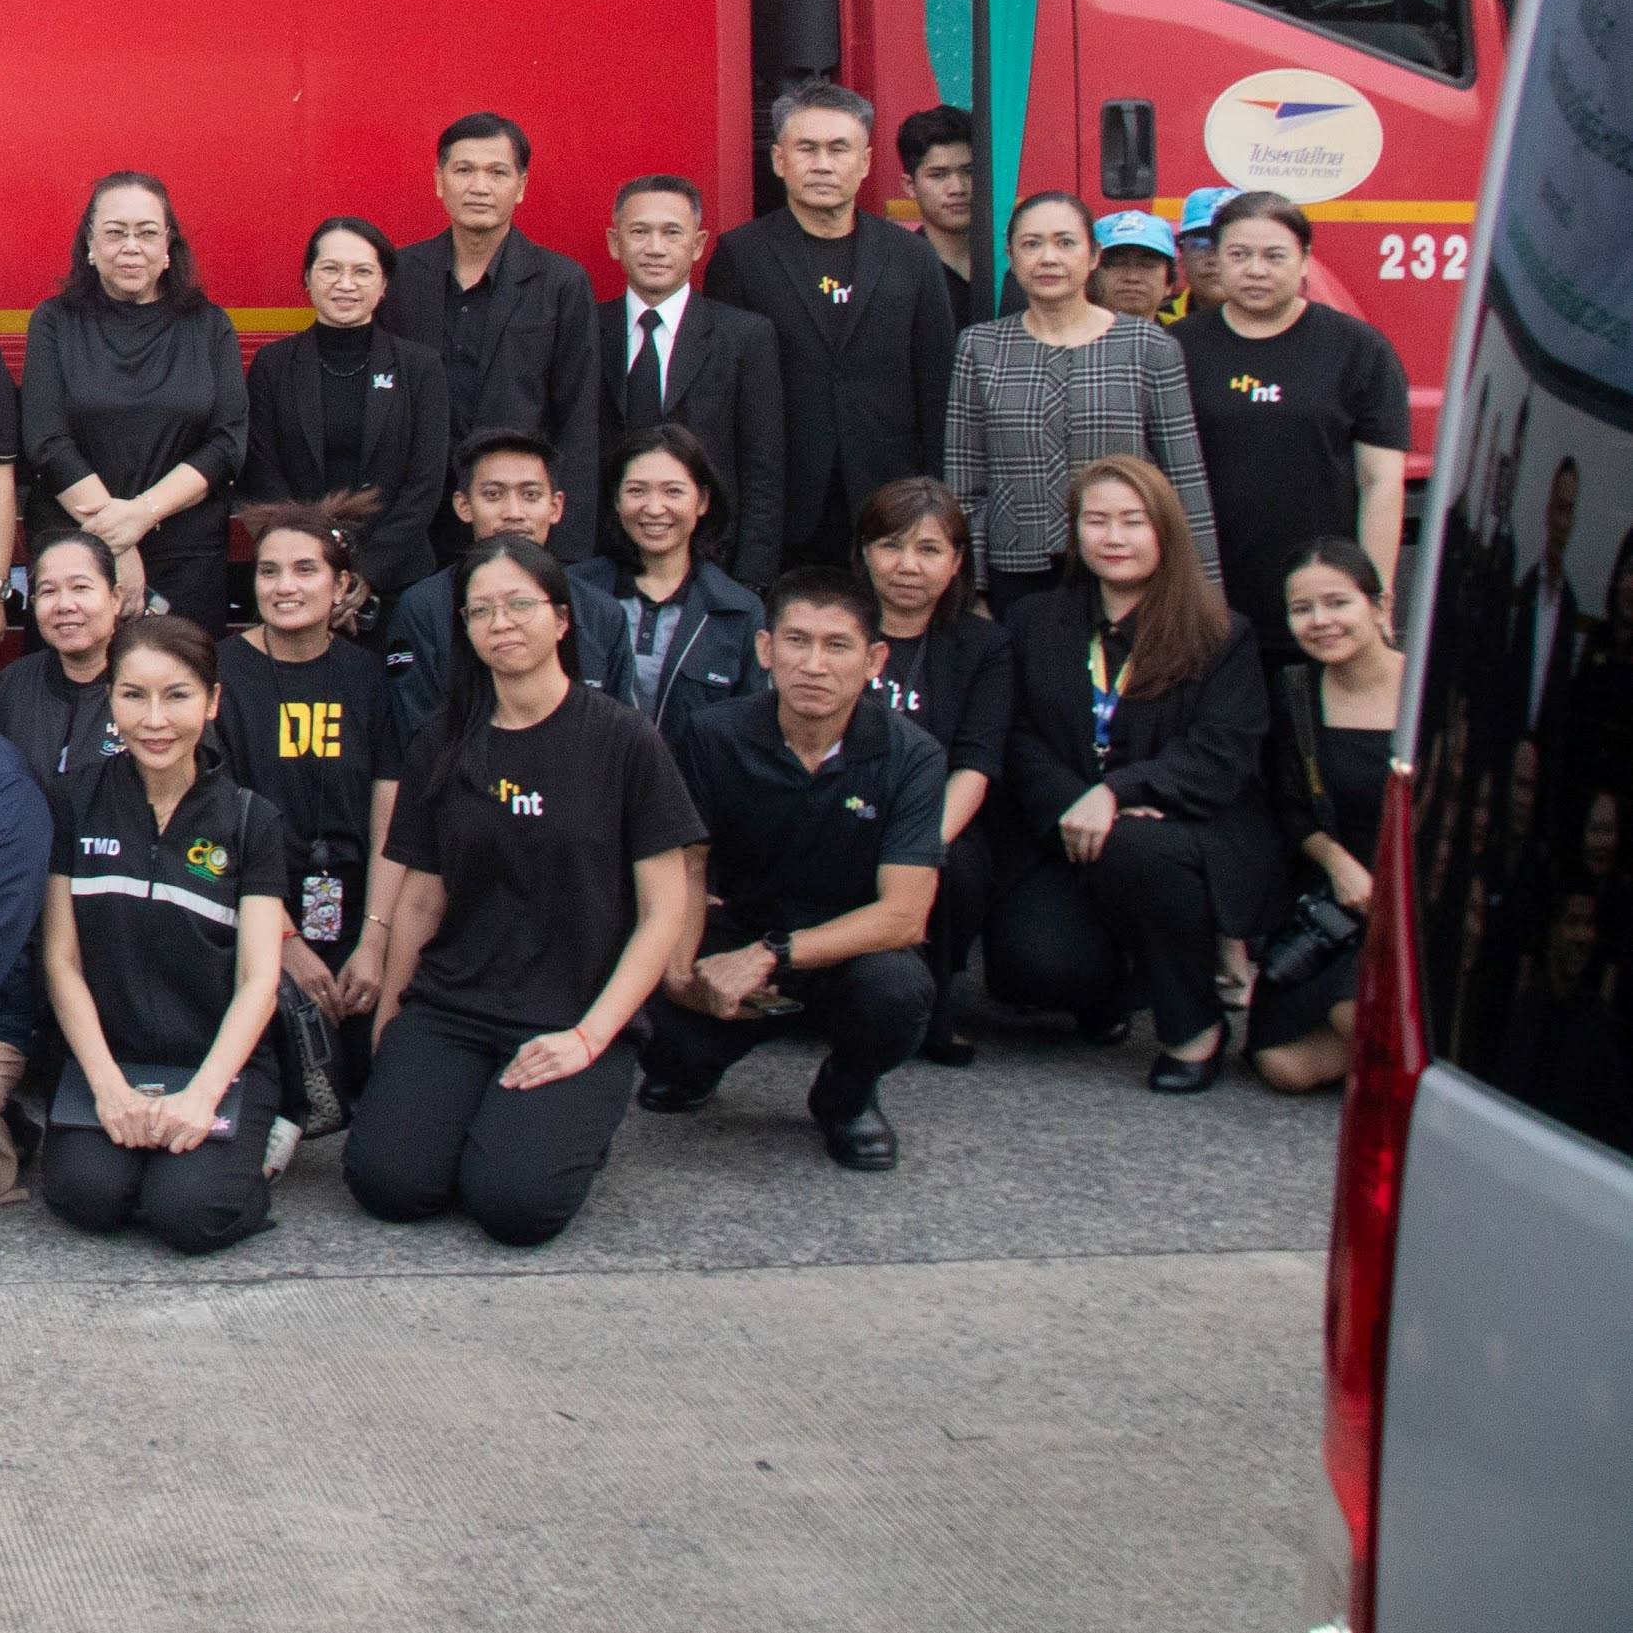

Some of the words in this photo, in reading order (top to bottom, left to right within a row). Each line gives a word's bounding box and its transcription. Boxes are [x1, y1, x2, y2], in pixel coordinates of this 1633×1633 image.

[1251, 383, 1283, 403] nt
[278, 701, 343, 758] DE
[512, 791, 544, 817] nt
[79, 836, 122, 857] TMD
